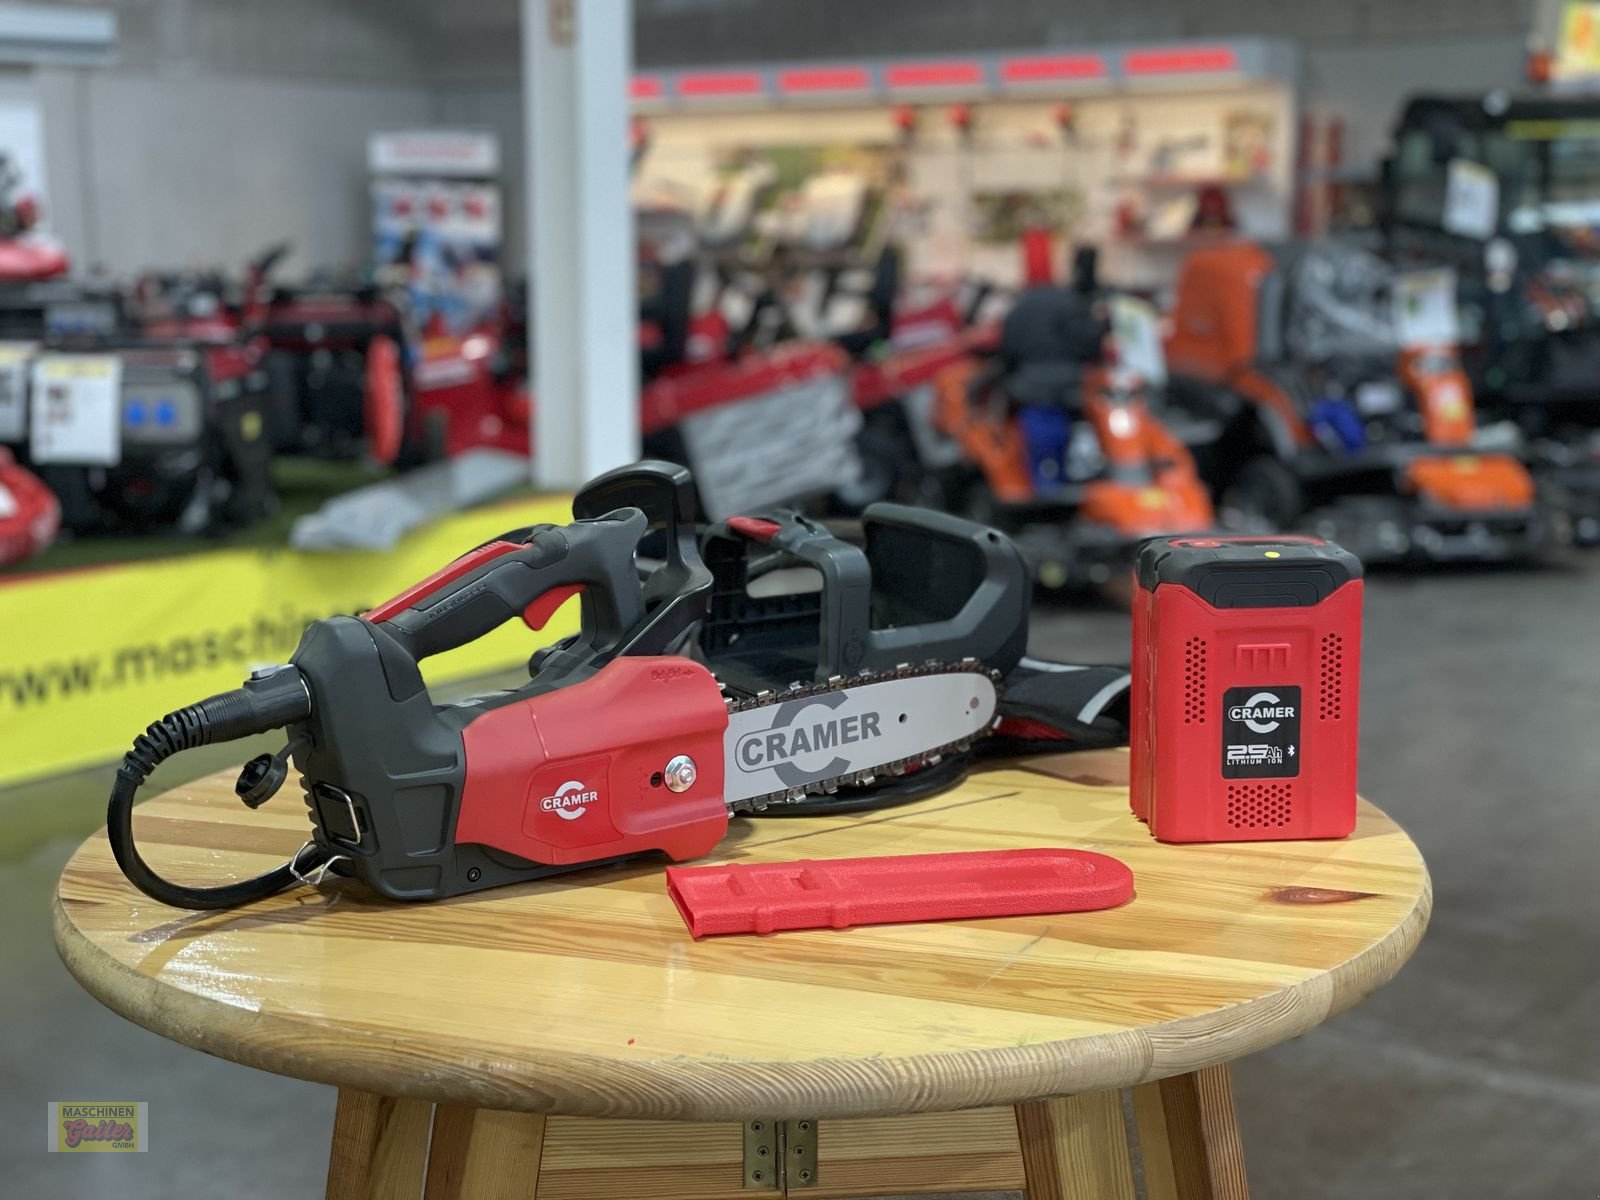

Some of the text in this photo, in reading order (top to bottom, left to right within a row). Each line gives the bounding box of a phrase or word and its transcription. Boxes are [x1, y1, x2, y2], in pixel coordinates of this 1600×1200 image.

[1231, 706, 1295, 719] CRAMER
[742, 711, 882, 766] CRAMER
[543, 791, 598, 810] CRAMER
